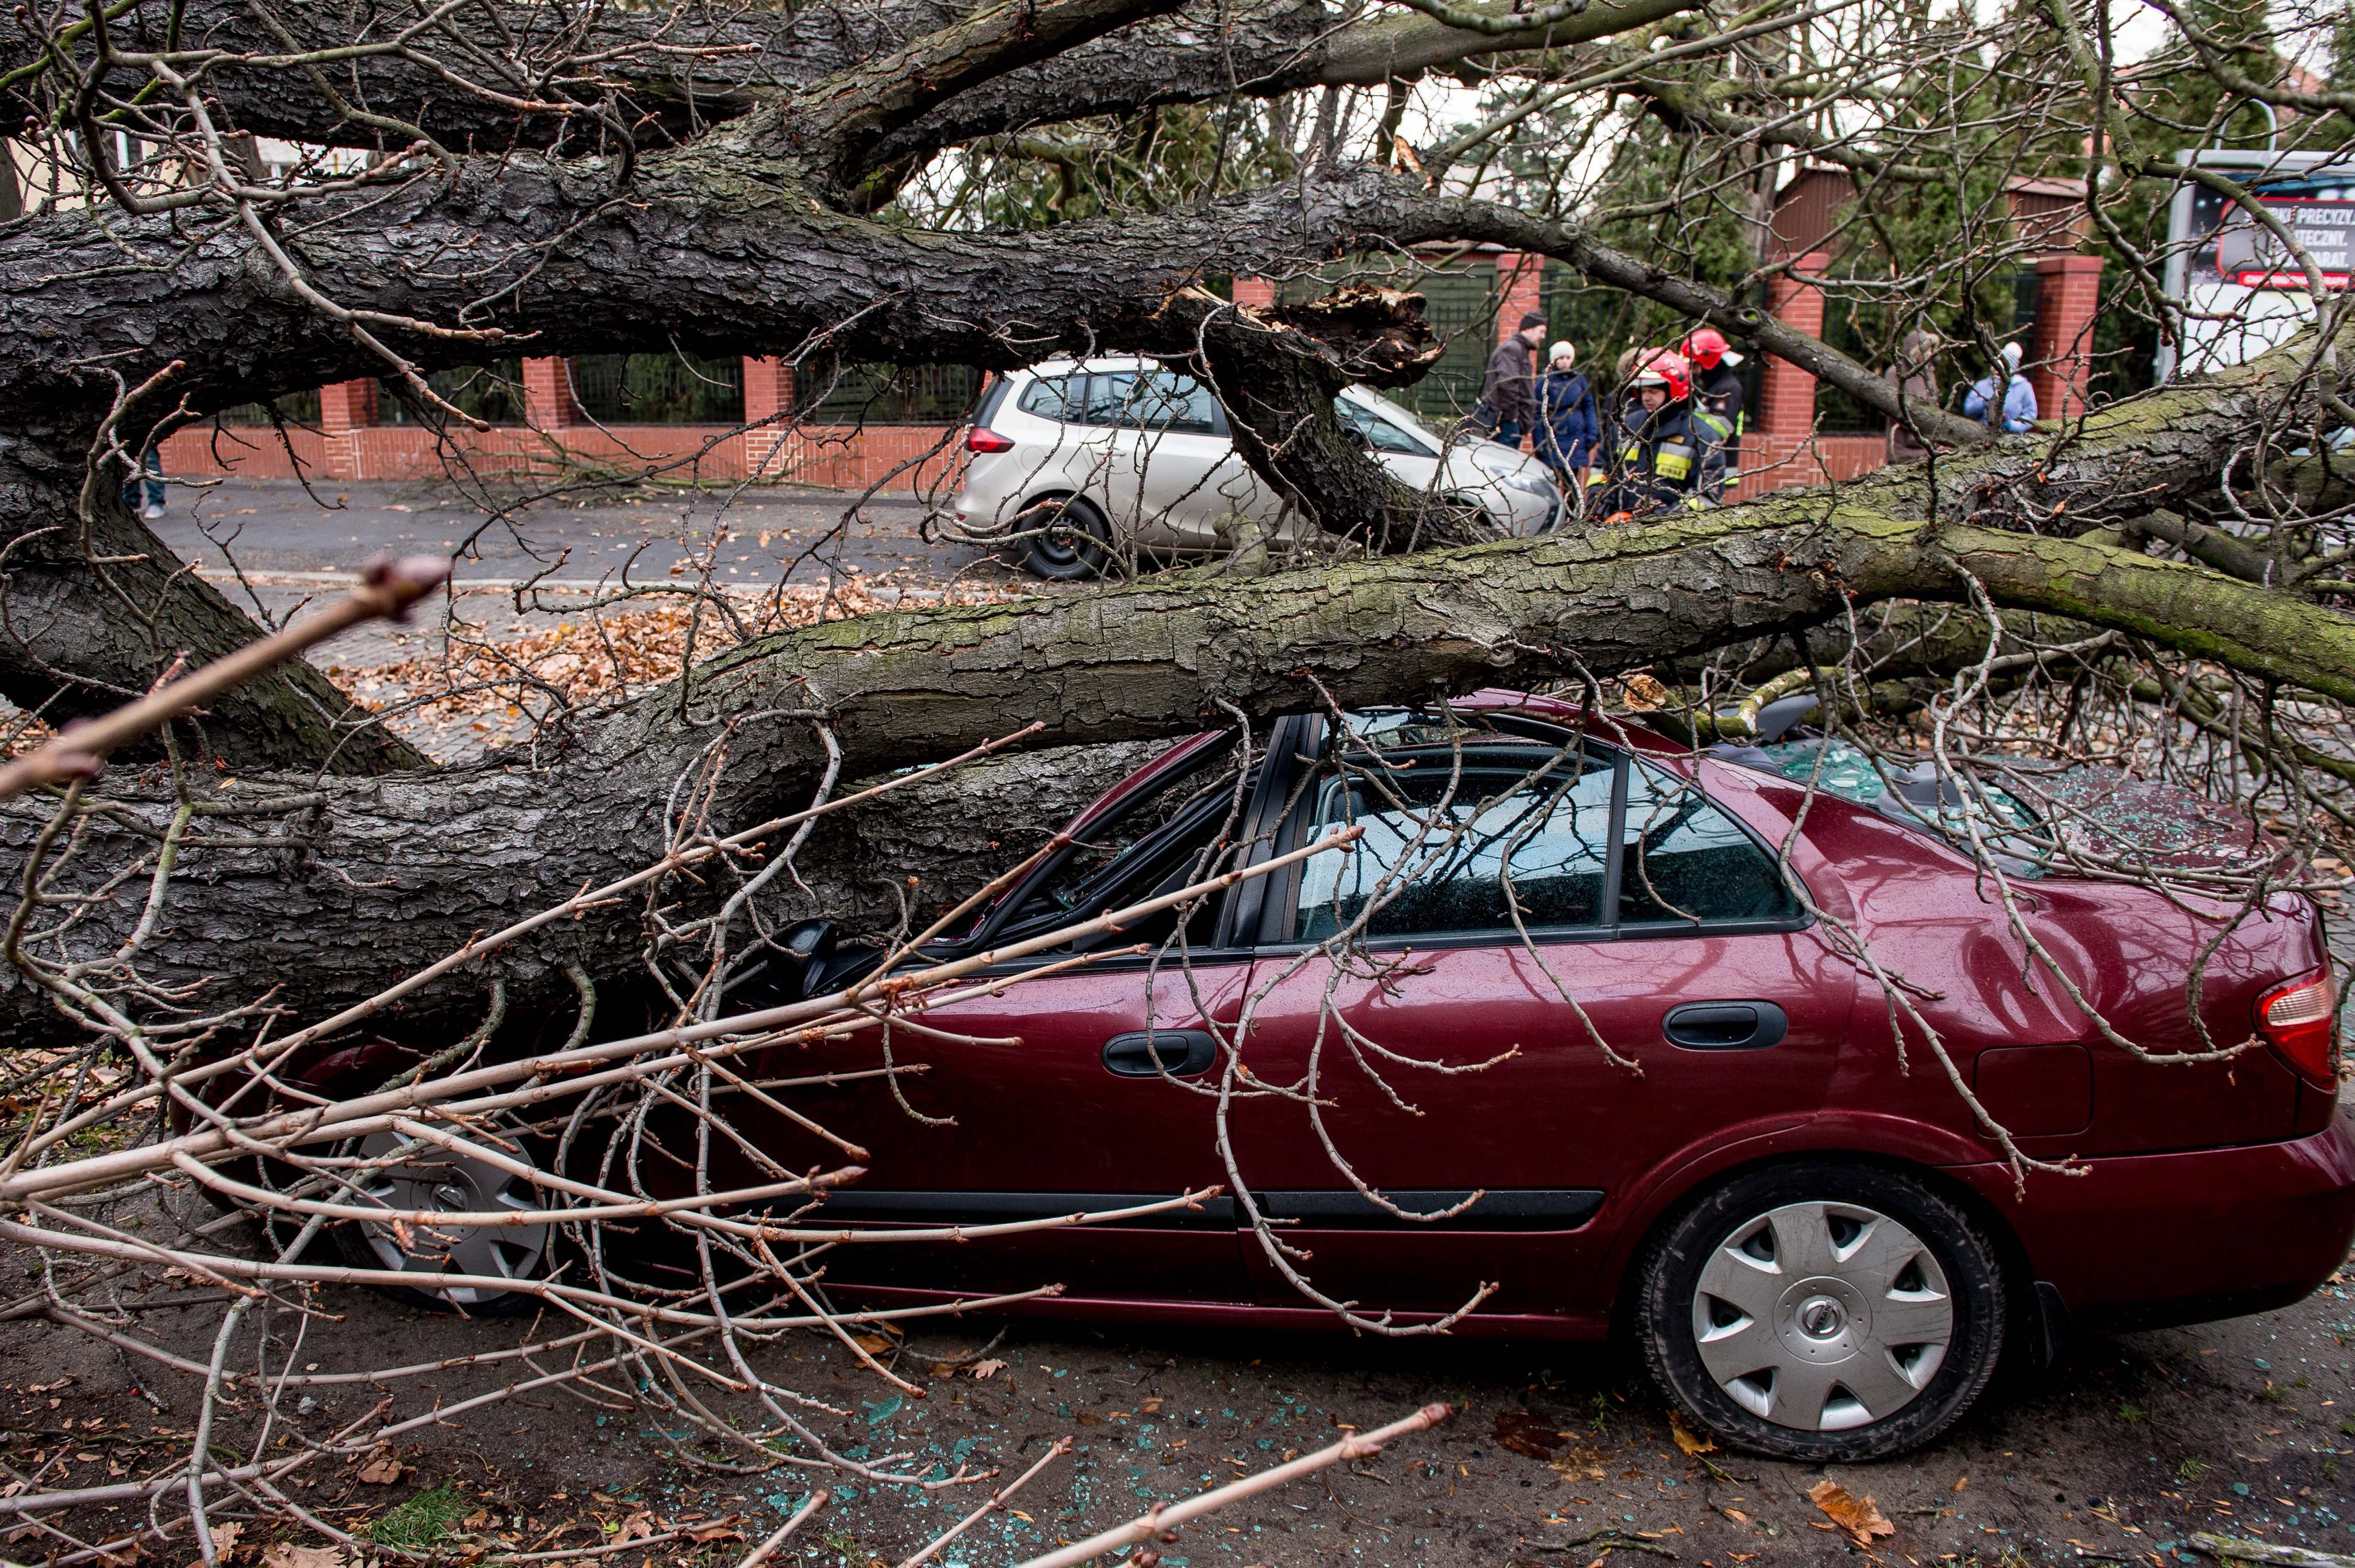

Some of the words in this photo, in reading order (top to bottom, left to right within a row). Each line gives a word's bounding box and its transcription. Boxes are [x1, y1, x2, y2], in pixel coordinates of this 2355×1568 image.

[2299, 207, 2355, 226] PRECYZY
[1664, 358, 1679, 375] 2
[1812, 1303, 1833, 1333] NISSAN
